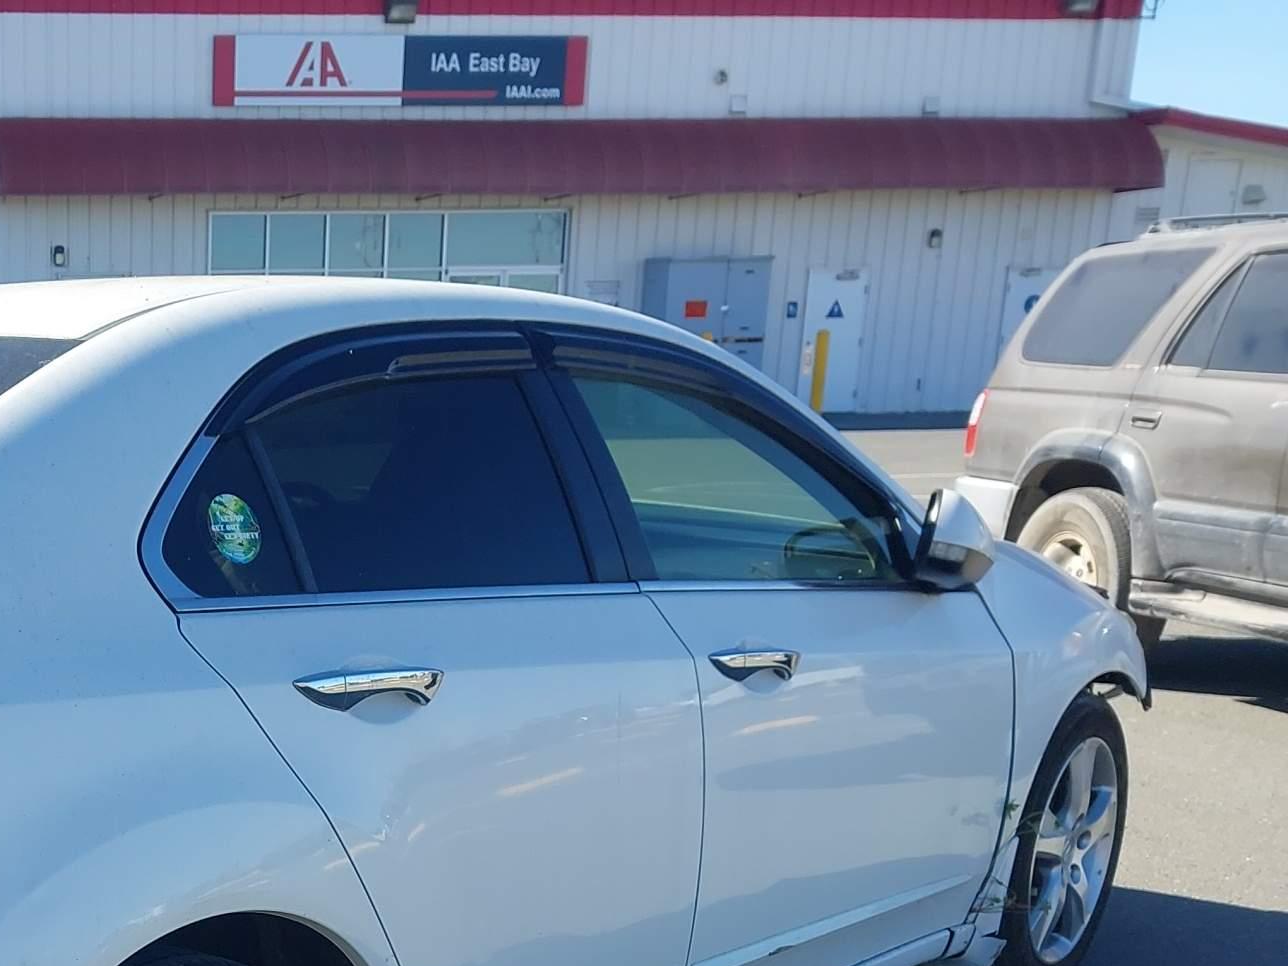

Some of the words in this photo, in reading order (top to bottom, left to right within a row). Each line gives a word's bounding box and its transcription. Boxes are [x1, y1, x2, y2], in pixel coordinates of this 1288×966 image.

[430, 53, 461, 73] IAA
[469, 53, 505, 73] East
[509, 53, 541, 77] Bay
[505, 85, 561, 98] IAAI.com
